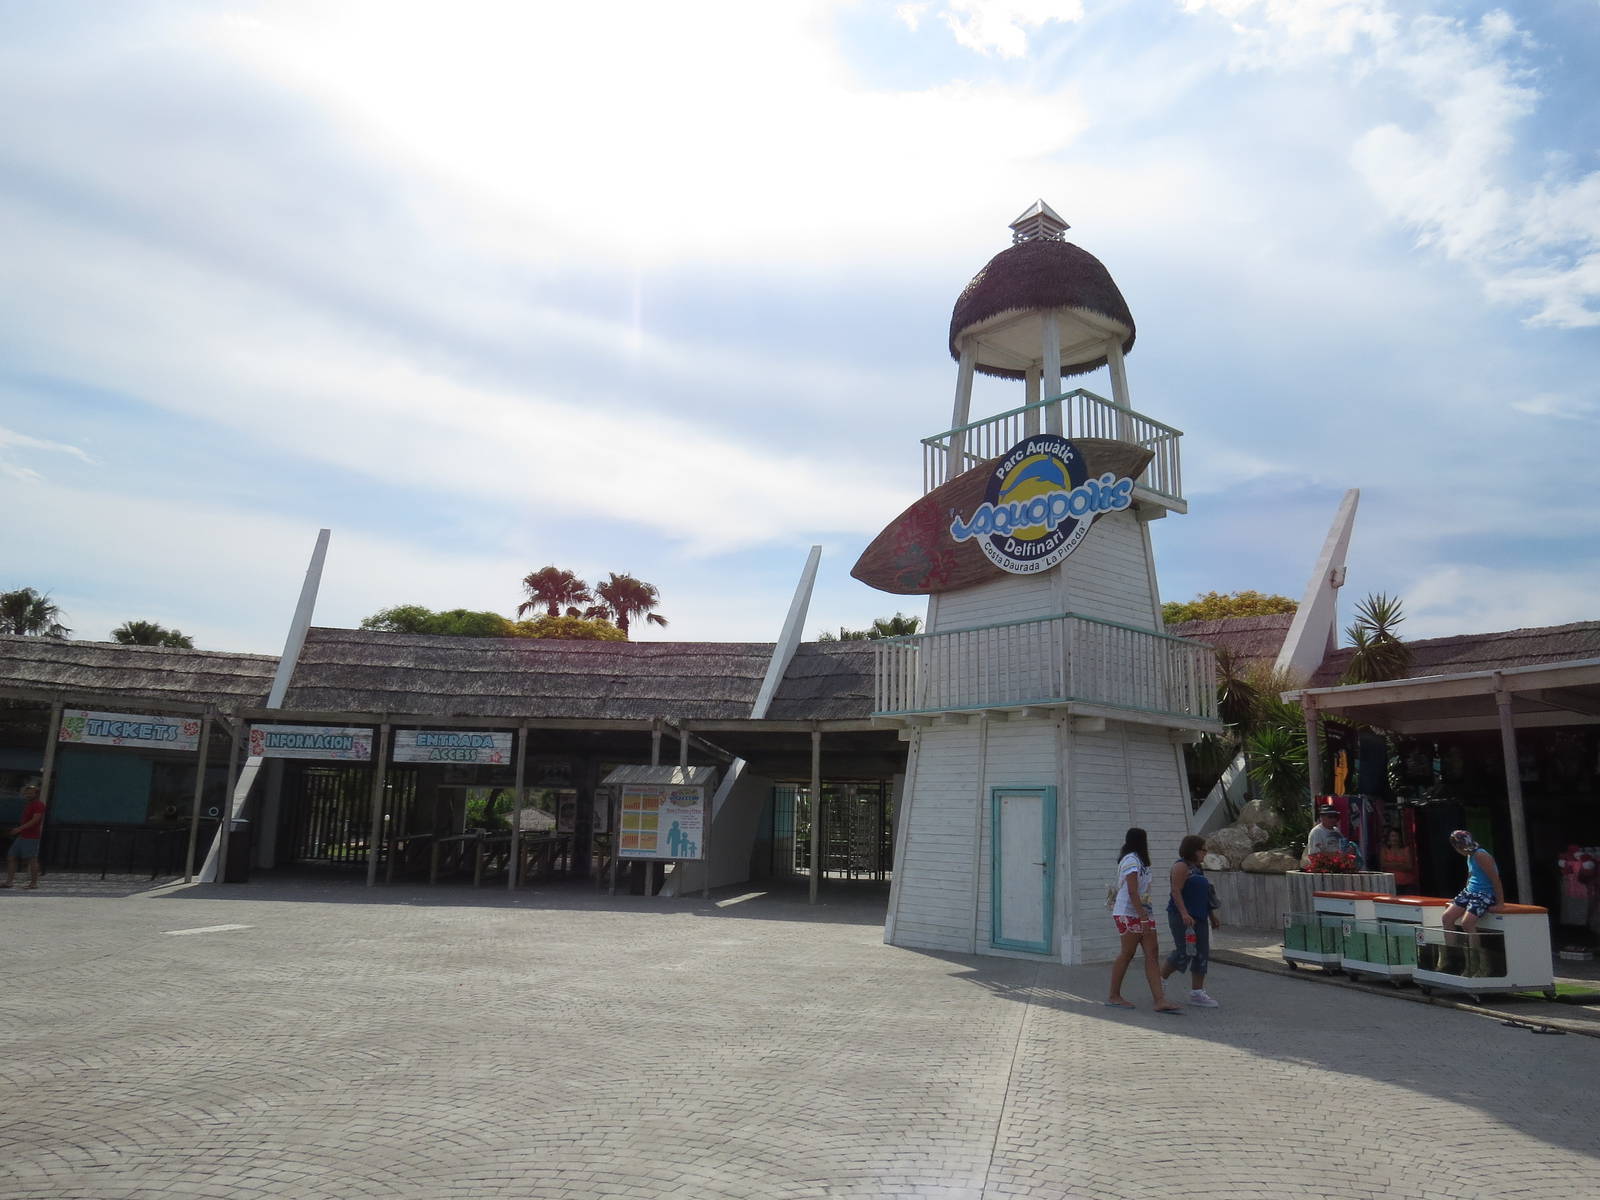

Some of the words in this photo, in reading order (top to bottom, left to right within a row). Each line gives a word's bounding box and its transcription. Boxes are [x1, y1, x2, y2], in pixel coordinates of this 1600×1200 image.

[996, 450, 1024, 480] Parc
[1004, 529, 1064, 556] Delfinari
[984, 542, 1004, 564] Costa
[1003, 559, 1041, 572] Daurada
[86, 718, 180, 742] TICKETS
[265, 733, 353, 751] INFORMACION
[416, 733, 495, 749] ENTRADA
[428, 748, 478, 762] ACCESS
